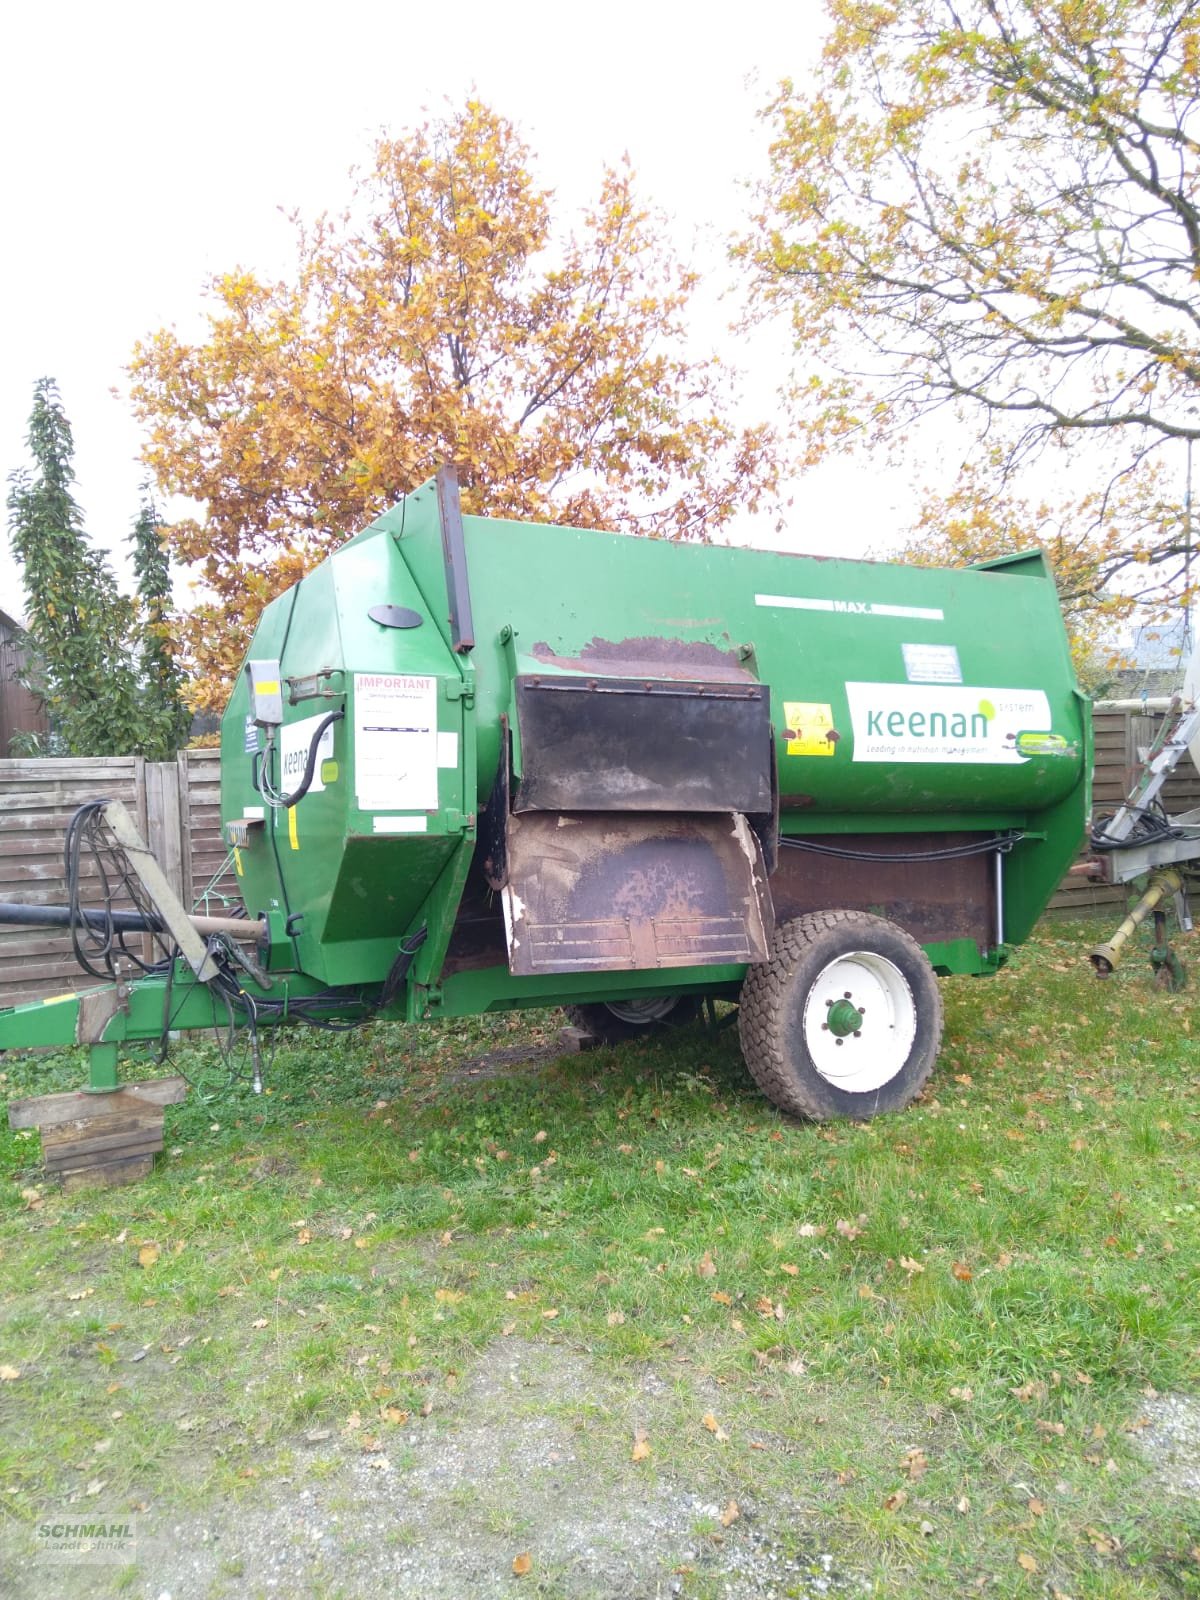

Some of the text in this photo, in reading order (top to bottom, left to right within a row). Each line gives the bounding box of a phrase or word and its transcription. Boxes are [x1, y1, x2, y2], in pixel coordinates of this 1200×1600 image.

[833, 600, 872, 614] MAX.
[359, 676, 431, 689] IMPORTANT
[866, 744, 896, 755] Leading
